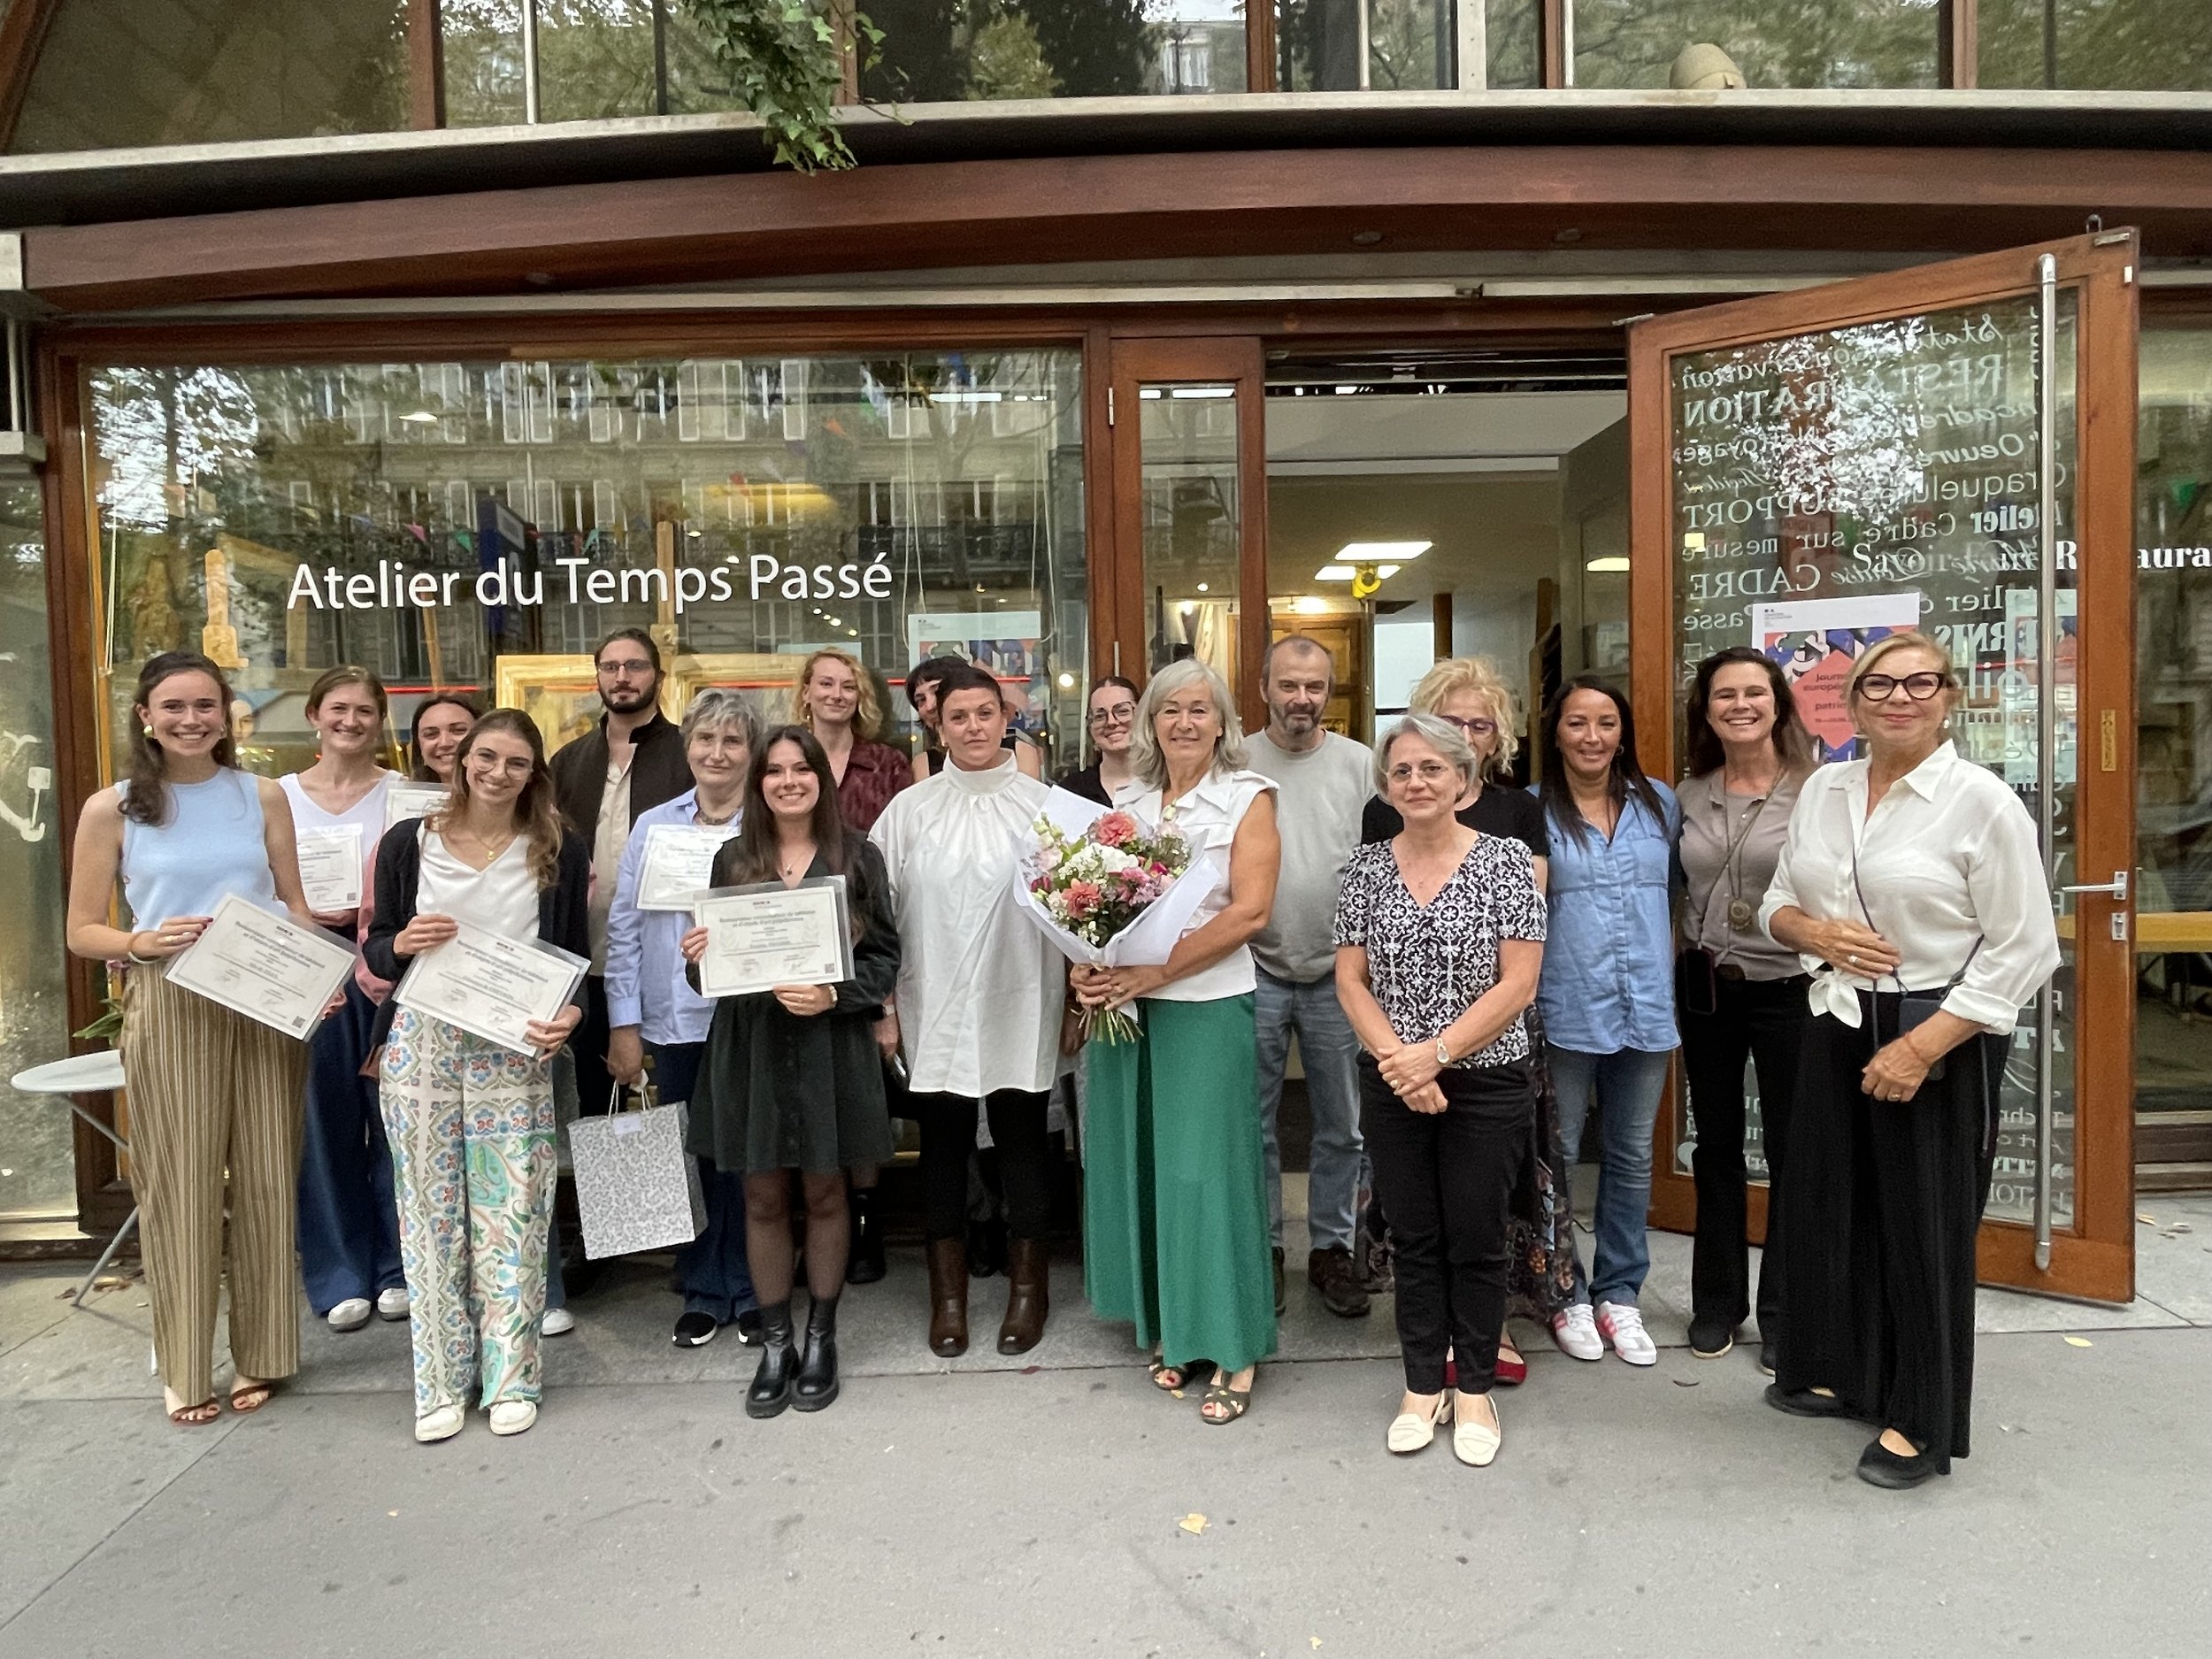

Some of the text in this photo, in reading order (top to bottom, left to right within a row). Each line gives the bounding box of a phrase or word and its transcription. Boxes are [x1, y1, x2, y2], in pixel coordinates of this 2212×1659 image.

[287, 551, 893, 614] Atelier du Temps Passé
